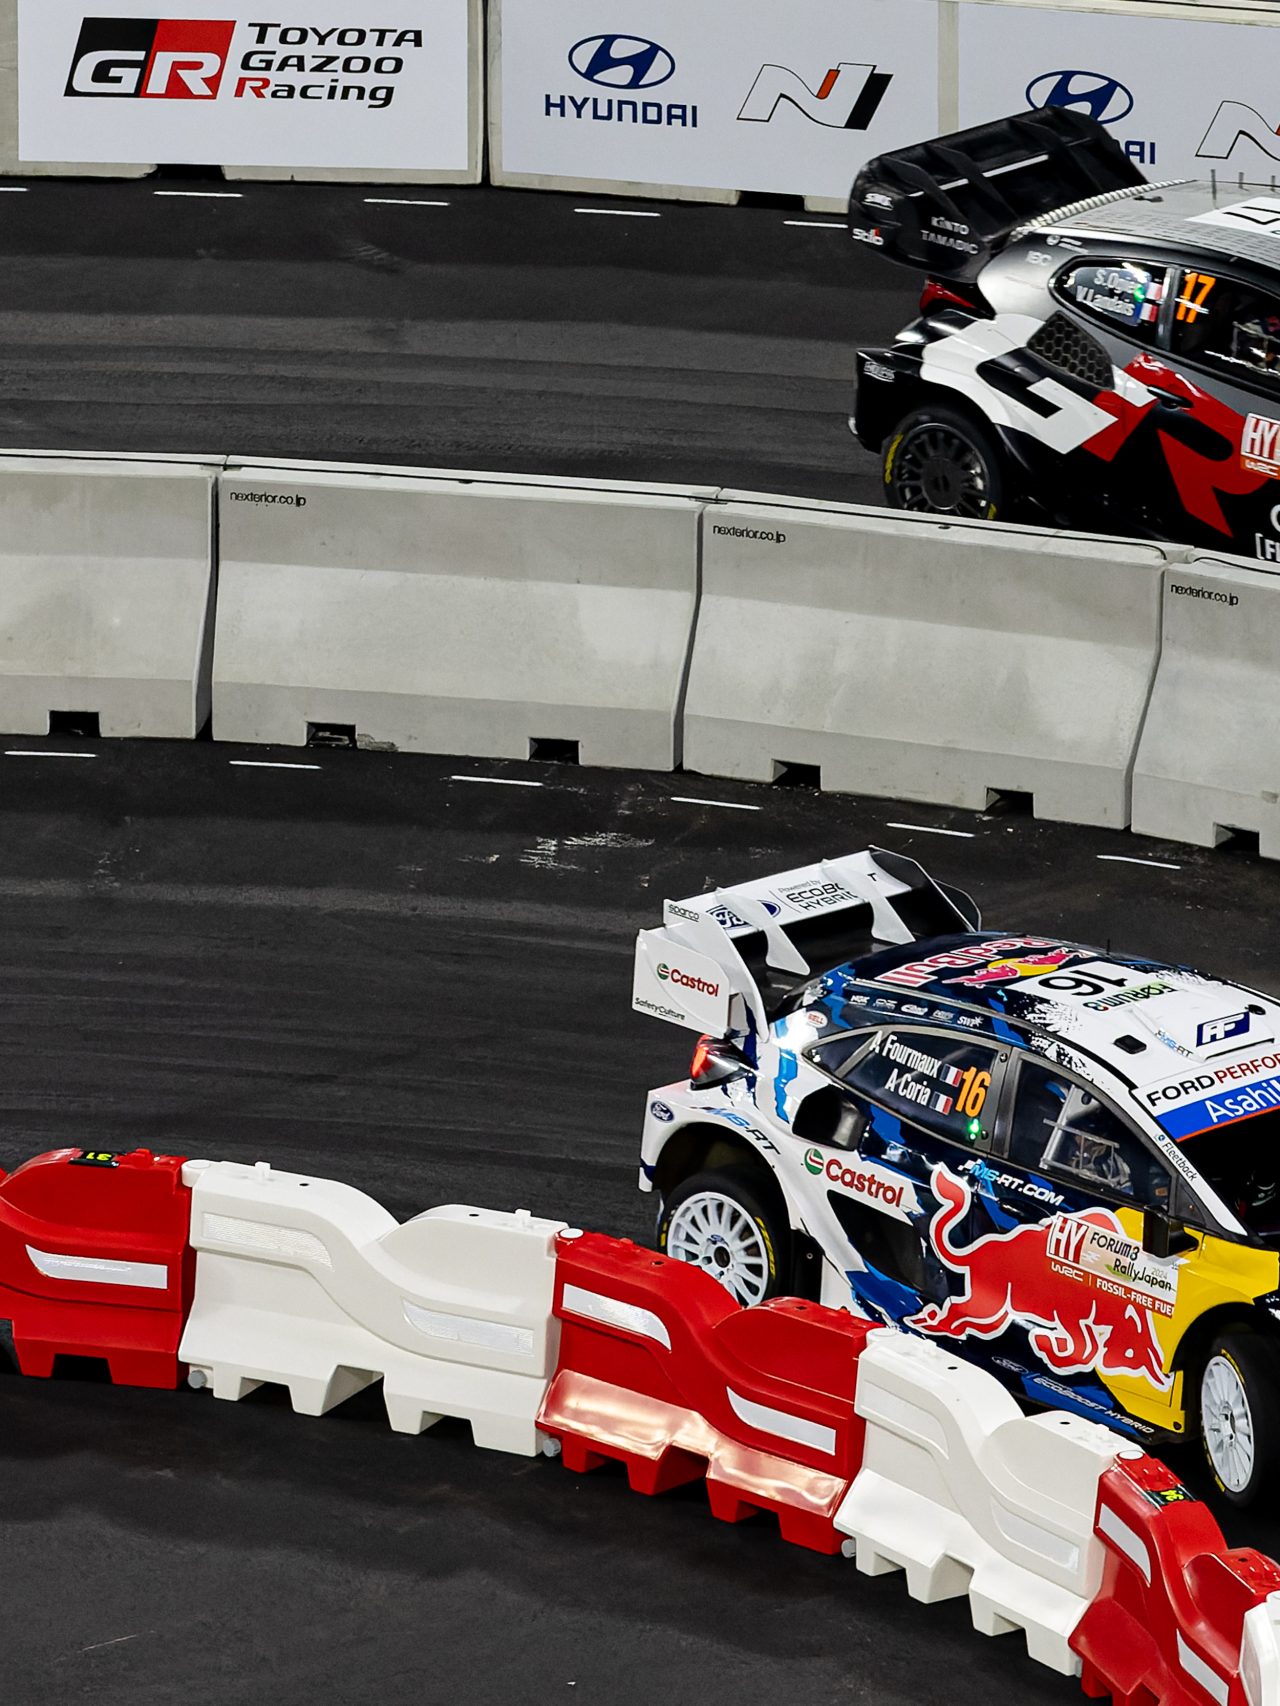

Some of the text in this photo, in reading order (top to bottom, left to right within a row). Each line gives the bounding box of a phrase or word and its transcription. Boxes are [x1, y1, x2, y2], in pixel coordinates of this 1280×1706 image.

[247, 23, 423, 47] TOYOTA
[72, 50, 222, 95] GR
[240, 51, 404, 73] GAZOO
[234, 77, 396, 108] Racing
[545, 94, 698, 128] HYUNDAI
[1176, 272, 1216, 323] 17
[1243, 417, 1280, 460] HY
[671, 969, 719, 997] Castrol
[1038, 969, 1128, 997] 16
[869, 1031, 942, 1078] A Fourmaux
[885, 1068, 931, 1106] A Coria
[955, 1066, 992, 1117] 16
[1162, 1142, 1197, 1181] Fleetback
[826, 1158, 904, 1208] Castrol
[1050, 1216, 1089, 1262] HY
[1051, 1261, 1084, 1282] WRC
[1096, 1278, 1153, 1309] FOSSIL-FREE
[1105, 1408, 1155, 1433] HYBRID
